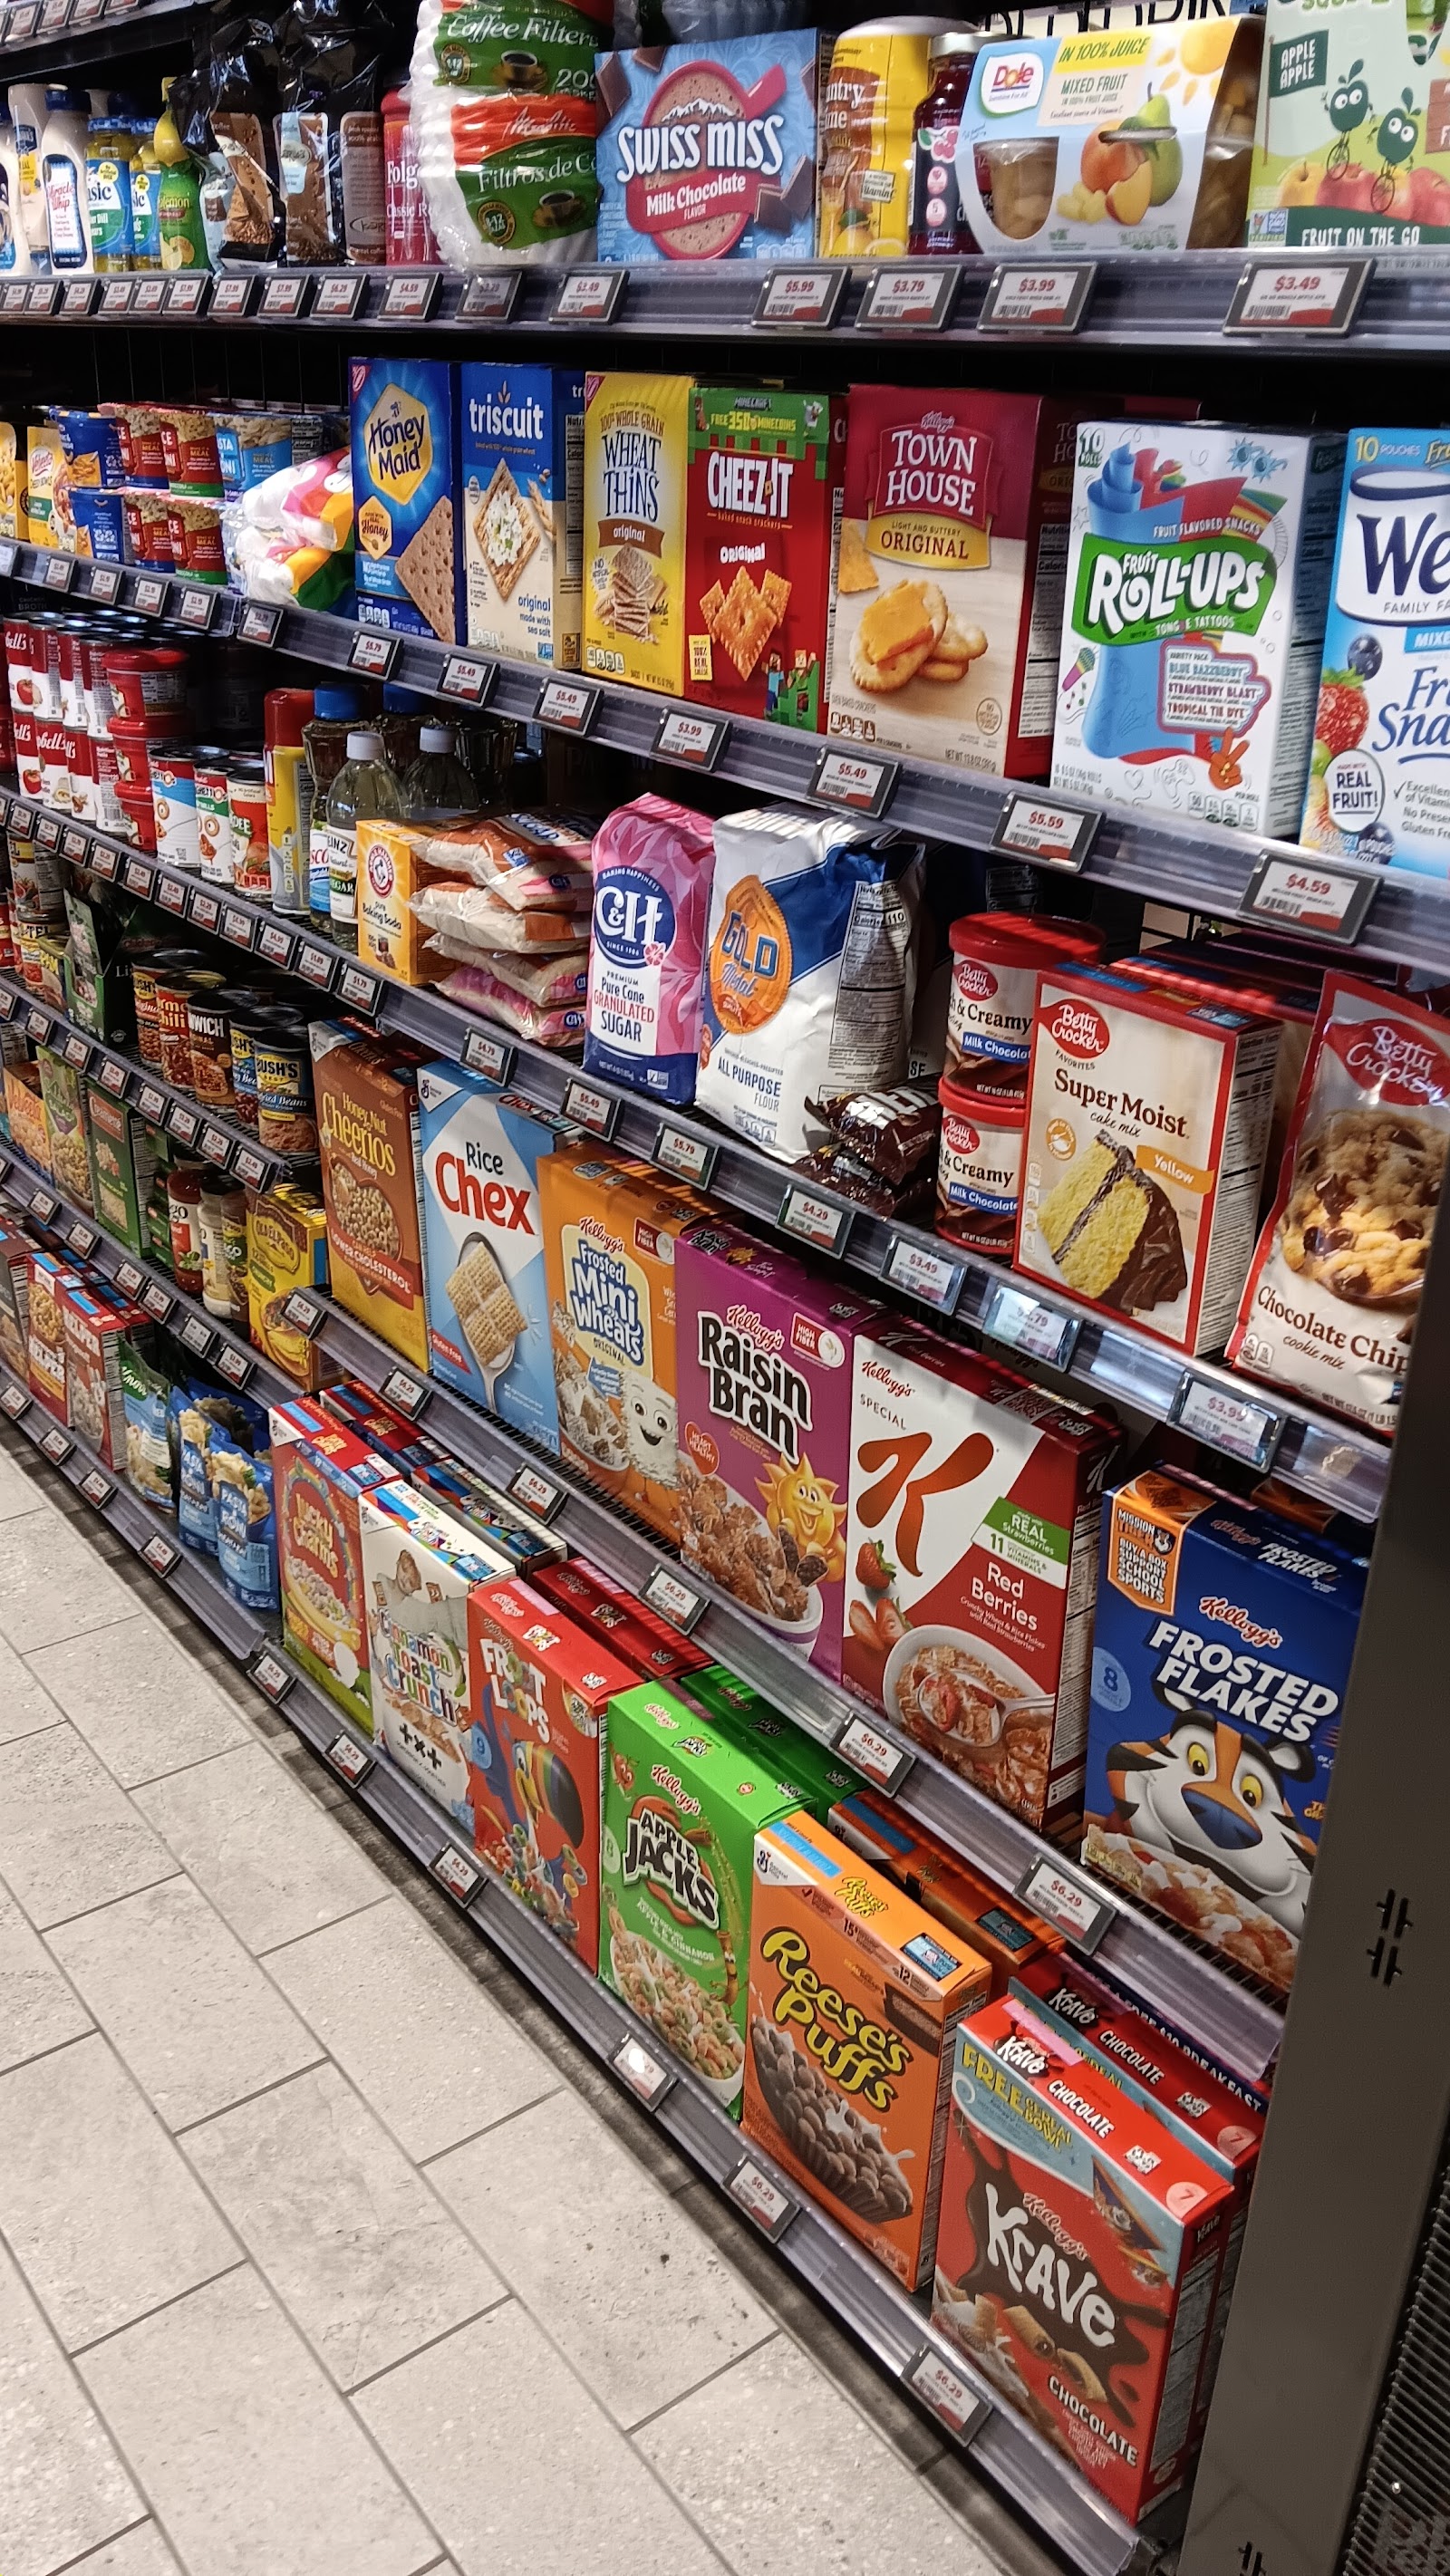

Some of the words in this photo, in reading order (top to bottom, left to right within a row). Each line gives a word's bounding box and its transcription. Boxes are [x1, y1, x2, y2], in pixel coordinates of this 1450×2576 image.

[447, 14, 518, 46] Coffee
[1059, 46, 1074, 63] IN
[1076, 42, 1110, 61] 100%
[1109, 37, 1150, 57] JUICE
[1281, 40, 1315, 66] APPLE
[992, 63, 1034, 87] Dole
[1061, 77, 1095, 94] MIXED
[1096, 73, 1127, 91] FRUIT
[1280, 61, 1315, 89] APPLE
[617, 124, 700, 182] SWISS
[707, 115, 784, 175] MISS
[478, 163, 544, 193] Filtros
[547, 159, 572, 181] de
[52, 198, 70, 211] Whip
[646, 193, 675, 217] Milk
[677, 176, 745, 208] Chocolate
[1301, 228, 1341, 246] FRUIT
[1347, 228, 1364, 246] ON
[1370, 228, 1395, 246] THE
[1402, 227, 1419, 245] GO
[400, 284, 418, 292] $4.59
[784, 281, 813, 293] $5.99
[892, 280, 924, 293] $3.79
[1019, 279, 1054, 292] $3.99
[1275, 277, 1320, 291] $3.49
[469, 397, 543, 439] triscuit
[734, 396, 772, 410] MINECRAFT
[369, 414, 424, 451] Honey
[616, 410, 637, 428] WHOLE
[639, 412, 664, 435] GRAIN
[711, 413, 729, 427] FREE
[758, 416, 797, 431] MINECOINS
[379, 449, 420, 480] Maid
[602, 430, 662, 473] WHEAT
[892, 429, 977, 474] TOWN
[885, 469, 976, 516] HOUSE
[613, 525, 645, 543] original
[892, 522, 912, 531] LIGHT
[1154, 524, 1176, 539] FRUIT
[1179, 518, 1222, 535] FLAVORED
[1225, 516, 1261, 535] SNACKS
[881, 531, 969, 560] ORIGINAL
[518, 594, 551, 612] original
[1384, 602, 1430, 613] FAMILY
[520, 613, 535, 622] made
[537, 616, 551, 627] with
[527, 624, 538, 634] sea
[539, 626, 551, 638] salt
[366, 641, 381, 651] $5.79
[458, 665, 475, 676] $5.49
[556, 690, 576, 703] $5.49
[678, 722, 701, 736] $3.99
[837, 762, 866, 779] $5.49
[1337, 770, 1372, 788] REAL
[1333, 791, 1378, 809] FRUIT!
[1029, 810, 1063, 830] $5.59
[1285, 873, 1331, 895] $4.59
[362, 903, 384, 924] Baking
[384, 916, 401, 930] Soda
[596, 886, 663, 948] C&H
[722, 912, 779, 979] GOLD
[602, 979, 620, 998] Pure
[622, 984, 644, 1004] Cane
[607, 970, 638, 986] PREMIUM
[720, 964, 757, 997] Medal
[594, 989, 654, 1024] GRANULATED
[967, 1004, 1033, 1031] Creamy
[1061, 1004, 1098, 1038] Betty
[600, 1013, 642, 1042] SUGAR
[1051, 1023, 1105, 1054] Crocker
[1055, 1049, 1096, 1070] FAVORITES
[1371, 1025, 1436, 1073] Betty
[719, 1057, 730, 1079] ALL
[732, 1064, 781, 1097] PURPOSE
[343, 1094, 368, 1124] Honey
[367, 1114, 386, 1137] Nut
[754, 1094, 779, 1112] FLOUR
[1054, 1068, 1117, 1113] Super
[1122, 1095, 1188, 1140] Moist
[322, 1093, 396, 1177] Cheerios
[1090, 1111, 1116, 1131] cake
[1118, 1120, 1141, 1138] mix
[466, 1142, 503, 1176] Rice
[673, 1137, 695, 1154] $5.79
[952, 1159, 1013, 1187] Creamy
[1154, 1153, 1194, 1185] Yellow
[435, 1152, 536, 1236] Chex
[803, 1201, 828, 1220] $4.29
[579, 1216, 625, 1253] Kellogg's
[579, 1242, 625, 1286] Frosted
[575, 1262, 638, 1326] Mini
[573, 1297, 644, 1363] Wheats
[727, 1304, 786, 1351] Kellogg's
[796, 1319, 816, 1338] HIGH
[1258, 1284, 1348, 1349] Chocolate
[795, 1329, 816, 1350] FIBER
[1282, 1336, 1319, 1362] cookie
[1320, 1349, 1345, 1373] mix
[699, 1313, 812, 1431] Raisin
[862, 1360, 915, 1397] Kellogg's
[710, 1368, 800, 1464] Bran
[859, 1394, 906, 1431] SPECIAL
[856, 1432, 995, 1577] K
[1011, 1514, 1048, 1542] REAL
[1117, 1509, 1155, 1534] MISSION
[991, 1533, 1003, 1554] 11
[1002, 1522, 1055, 1557] Strawberries
[1119, 1538, 1138, 1556] BUY
[1139, 1548, 1146, 1558] A
[1147, 1551, 1167, 1568] BOX
[1117, 1560, 1165, 1590] SCHOOL
[1118, 1548, 1167, 1577] SUPPORT
[663, 1580, 687, 1602] $6.29
[987, 1562, 1024, 1598] Red
[1117, 1570, 1164, 1604] SPORTS
[972, 1577, 1038, 1631] Berries
[1199, 1596, 1283, 1649] Kellogg's
[392, 1644, 442, 1688] Toast
[1104, 1666, 1117, 1692] 8
[1148, 1620, 1339, 1717] FROSTED
[386, 1657, 459, 1726] Crunch
[1156, 1657, 1317, 1742] FLAKES
[860, 1732, 888, 1757] $6.29
[651, 1763, 701, 1816] Kellogg's
[639, 1810, 698, 1872] APPLE
[450, 1856, 469, 1877] $6.29
[624, 1817, 721, 1931] JACKS
[1050, 1879, 1082, 1908] $6.29
[760, 1926, 914, 2079] Reese's
[774, 1984, 895, 2112] Puffs
[1099, 2029, 1165, 2086] CHOCOLATE
[962, 2042, 1026, 2117] FREE
[1025, 2096, 1075, 2149] CEREAL
[1048, 2079, 1115, 2139] CHOCOLATE
[1024, 2110, 1063, 2153] BOWL
[751, 2175, 775, 2205] $6.29
[1021, 2191, 1088, 2262] Kellogg's
[934, 2369, 964, 2399] $6.29
[1049, 2373, 1137, 2466] CHOCOLATE
